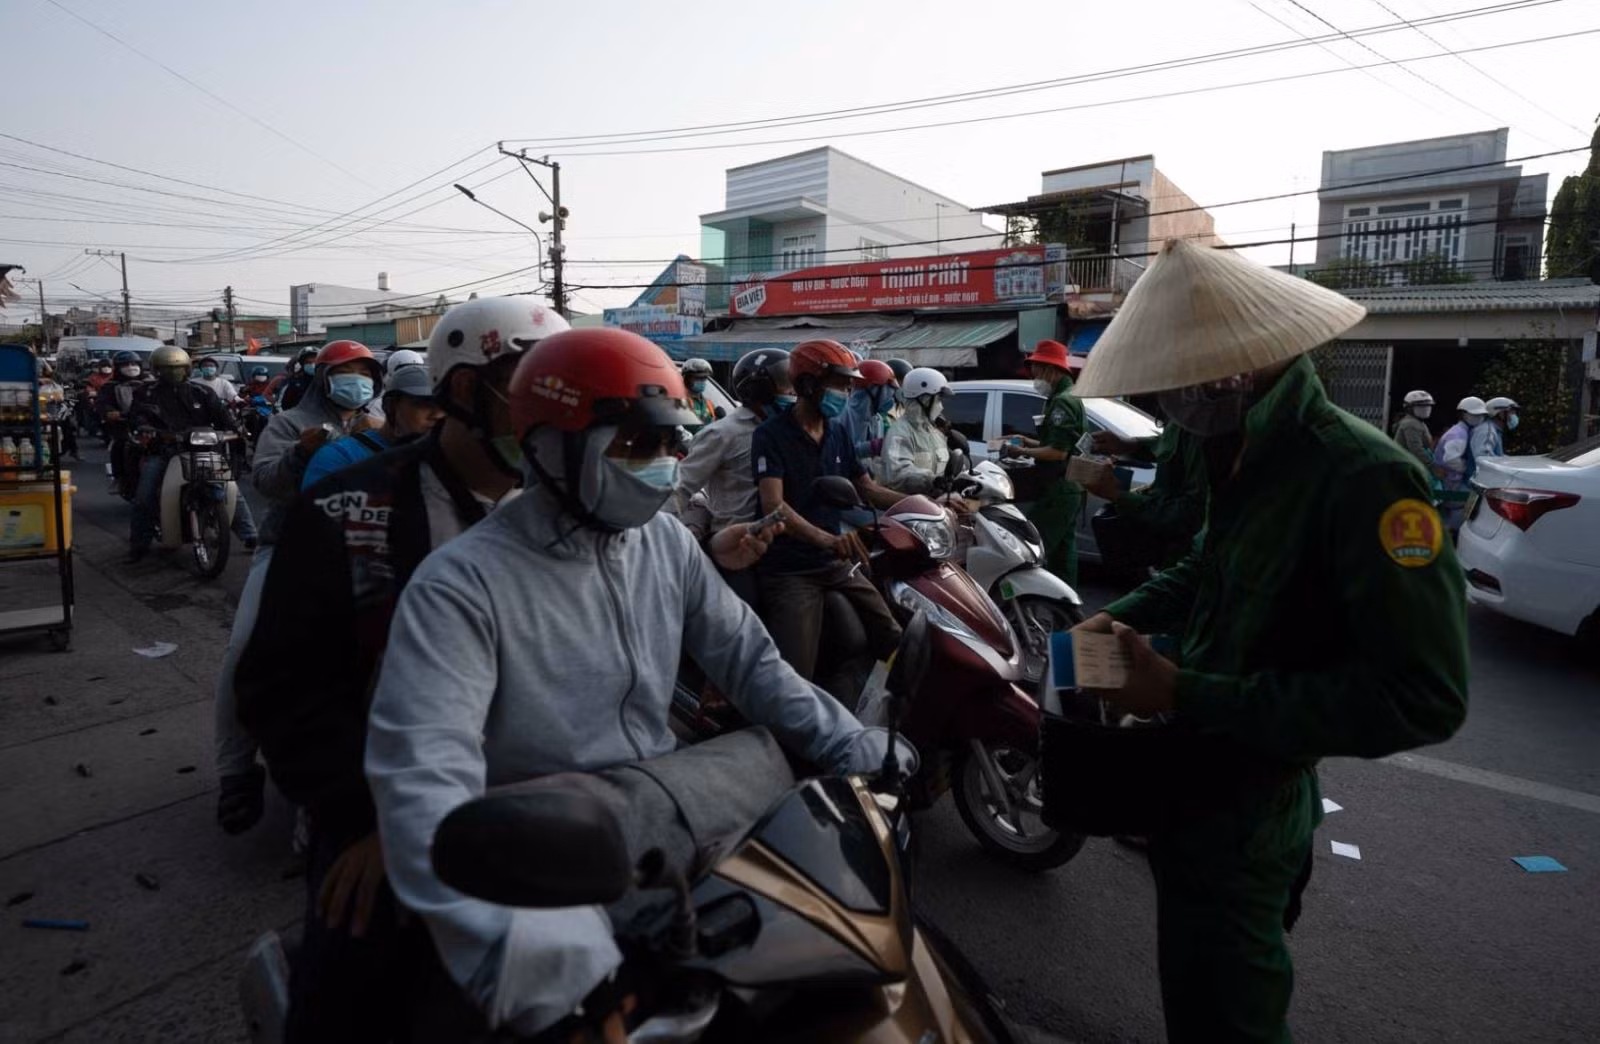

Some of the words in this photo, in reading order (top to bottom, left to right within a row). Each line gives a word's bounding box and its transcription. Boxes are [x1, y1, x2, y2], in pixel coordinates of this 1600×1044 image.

[880, 265, 924, 293] THỊNH
[928, 256, 970, 286] PHÁT
[736, 294, 749, 309] BIA
